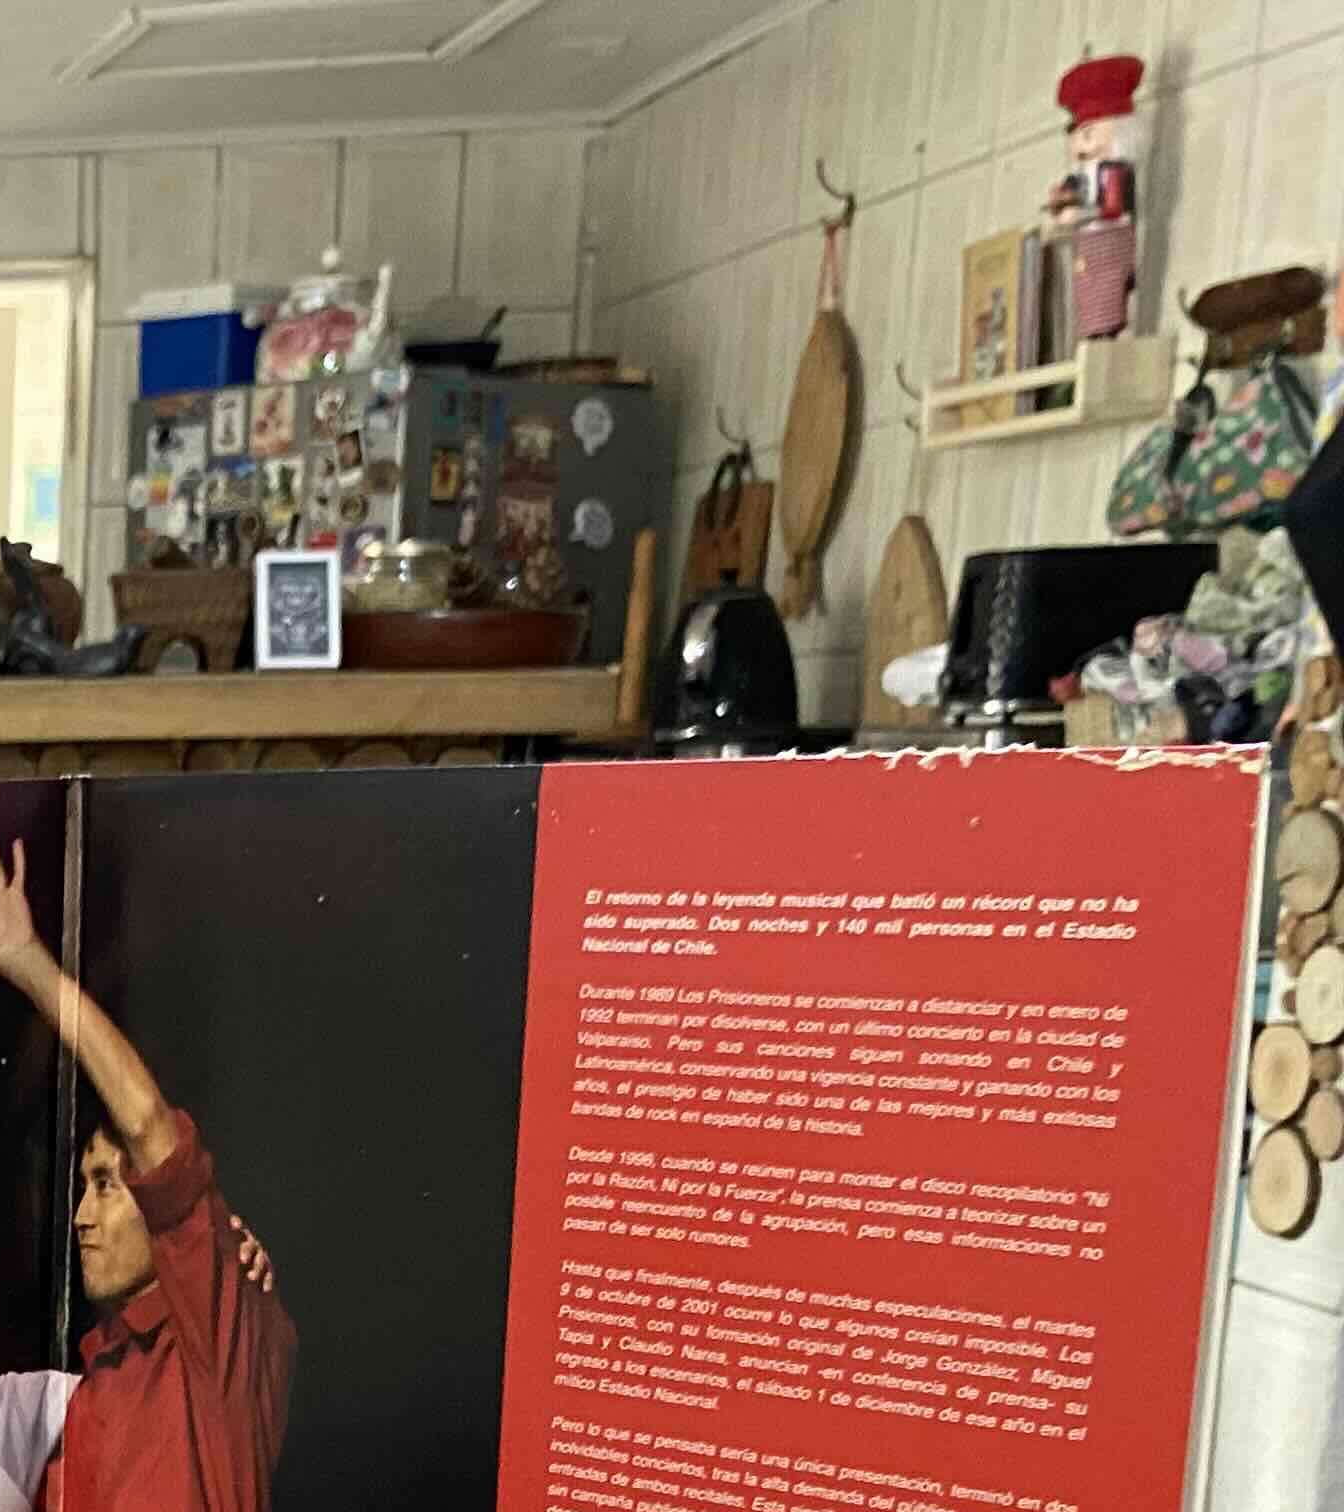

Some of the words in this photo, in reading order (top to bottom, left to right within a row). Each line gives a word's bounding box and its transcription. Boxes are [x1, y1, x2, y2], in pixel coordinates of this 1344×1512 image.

[585, 889, 603, 905] El
[606, 892, 662, 906] retorno
[666, 891, 688, 906] de
[691, 891, 708, 907] la
[712, 892, 776, 910] leyenda
[780, 893, 848, 908] musical
[851, 895, 886, 912] que
[941, 896, 967, 910] un
[1038, 898, 1075, 915] que
[1080, 898, 1108, 912] no
[1112, 896, 1139, 913] ha
[582, 937, 649, 953] Nacional
[650, 939, 672, 954] de
[673, 939, 717, 955] Chile.
[583, 913, 617, 929] sido
[624, 916, 700, 932] superado.
[707, 915, 741, 932] Dos
[748, 917, 809, 933] noches
[815, 921, 830, 937] y
[838, 918, 868, 934] 140
[874, 918, 904, 934] mil
[908, 922, 994, 938] personas
[1002, 924, 1027, 937] en
[1034, 921, 1056, 938] el
[1062, 922, 1137, 940] Estadio
[579, 983, 635, 1001] Durante
[677, 989, 705, 1004] Los
[708, 988, 791, 1007] Prisioneros
[793, 995, 815, 1009] se
[817, 996, 905, 1011] comienzan
[906, 999, 920, 1013] a
[921, 998, 1004, 1016] distanciar
[1005, 1004, 1020, 1020] y
[1020, 1004, 1045, 1018] en
[1048, 1006, 1100, 1020] enero
[1102, 1005, 1129, 1022] de
[667, 1035, 704, 1052] Pero
[715, 1041, 744, 1054] sus
[757, 1043, 835, 1059] canciones
[850, 1046, 904, 1065] siguen
[919, 1052, 992, 1068] sonando
[1007, 1057, 1032, 1069] en
[1047, 1055, 1094, 1074] Chile
[1108, 1063, 1123, 1079] y
[571, 1101, 623, 1118] bandas
[624, 1104, 645, 1119] de
[646, 1108, 678, 1121] rock
[680, 1111, 701, 1123] en
[763, 1115, 785, 1130] de
[786, 1116, 803, 1131] la
[616, 1081, 632, 1095] el
[634, 1084, 696, 1102] prestigio
[701, 1086, 722, 1101] de
[726, 1088, 771, 1104] haber
[776, 1092, 809, 1107] sido
[813, 1096, 845, 1110] una
[849, 1096, 872, 1112] de
[876, 1098, 902, 1114] las
[908, 1102, 976, 1119] mejores
[980, 1108, 993, 1123] y
[1043, 1111, 1117, 1129] exitosas
[563, 1217, 607, 1232] pasan
[608, 1220, 627, 1234] de
[630, 1224, 654, 1237] ser
[655, 1227, 686, 1241] solo
[561, 1260, 603, 1278] Hasta
[604, 1268, 633, 1282] que
[785, 1288, 807, 1303] de
[809, 1293, 872, 1311] muchas
[1012, 1315, 1032, 1330] el
[1034, 1320, 1096, 1338] martes
[559, 1282, 571, 1296] 9
[574, 1285, 594, 1299] de
[598, 1290, 651, 1307] octubre
[656, 1295, 677, 1310] de
[681, 1298, 718, 1315] 2001
[724, 1306, 773, 1322] ocurre
[778, 1310, 793, 1325] lo
[798, 1316, 830, 1330] que
[835, 1319, 899, 1339] algunos
[1058, 1345, 1093, 1365] Los
[559, 1327, 595, 1345] Tapia
[601, 1336, 612, 1350] y
[619, 1336, 673, 1356] Claudio
[739, 1356, 809, 1375] anuncian
[852, 1372, 947, 1396] conferencia
[956, 1385, 980, 1400] de
[1064, 1402, 1088, 1416] su
[646, 1319, 674, 1333] con
[680, 1324, 700, 1337] su
[787, 1338, 846, 1356] original
[851, 1346, 874, 1361] de
[881, 1349, 928, 1370] Jorge
[1031, 1368, 1092, 1390] Miguel
[551, 1416, 585, 1433] Pero
[587, 1422, 601, 1437] lo
[603, 1427, 631, 1441] que
[633, 1432, 652, 1445] se
[654, 1436, 716, 1456] pensaba
[761, 1454, 790, 1469] una
[1017, 1497, 1042, 1510] en
